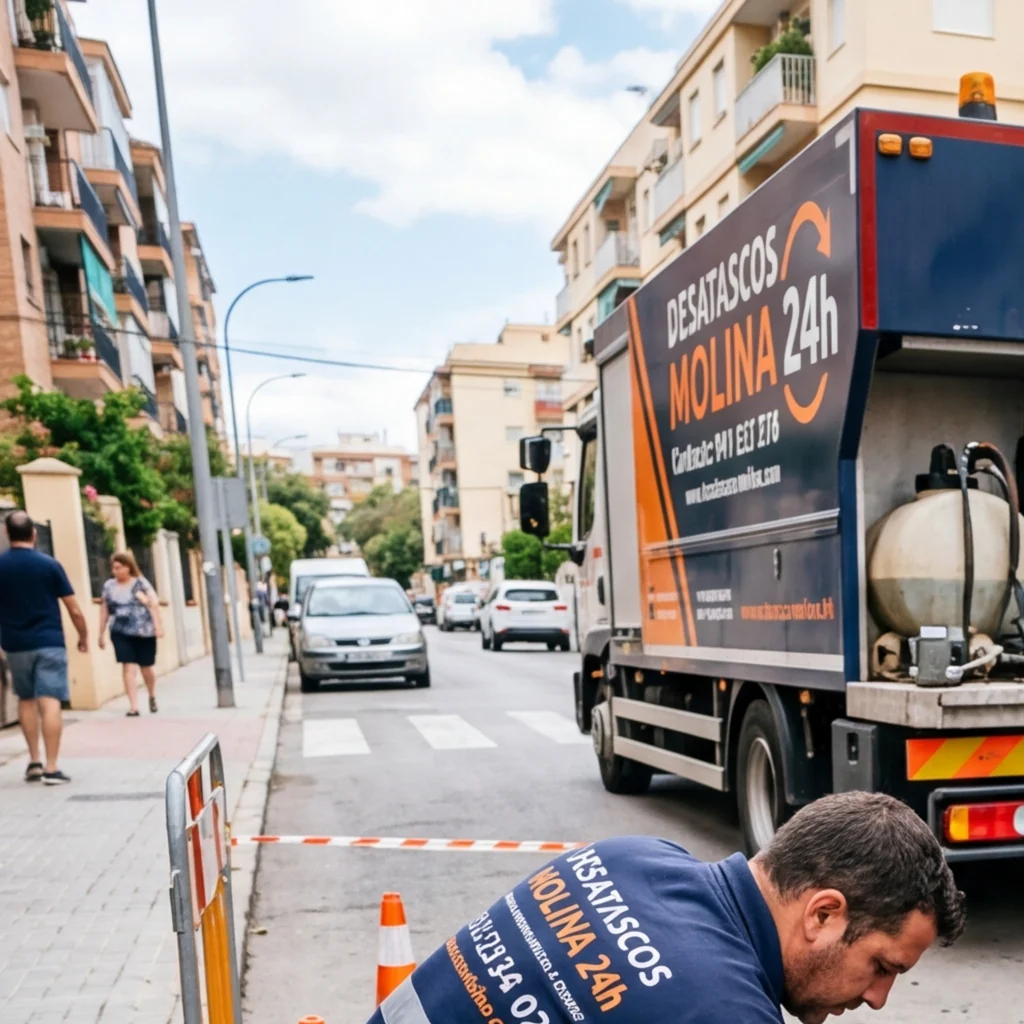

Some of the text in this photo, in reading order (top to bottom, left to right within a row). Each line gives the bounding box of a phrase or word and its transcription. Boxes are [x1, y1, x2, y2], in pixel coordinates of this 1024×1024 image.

[666, 225, 779, 349] DESATASCOS
[670, 273, 838, 430] MOLINA 24h
[575, 954, 628, 1012] 24h
